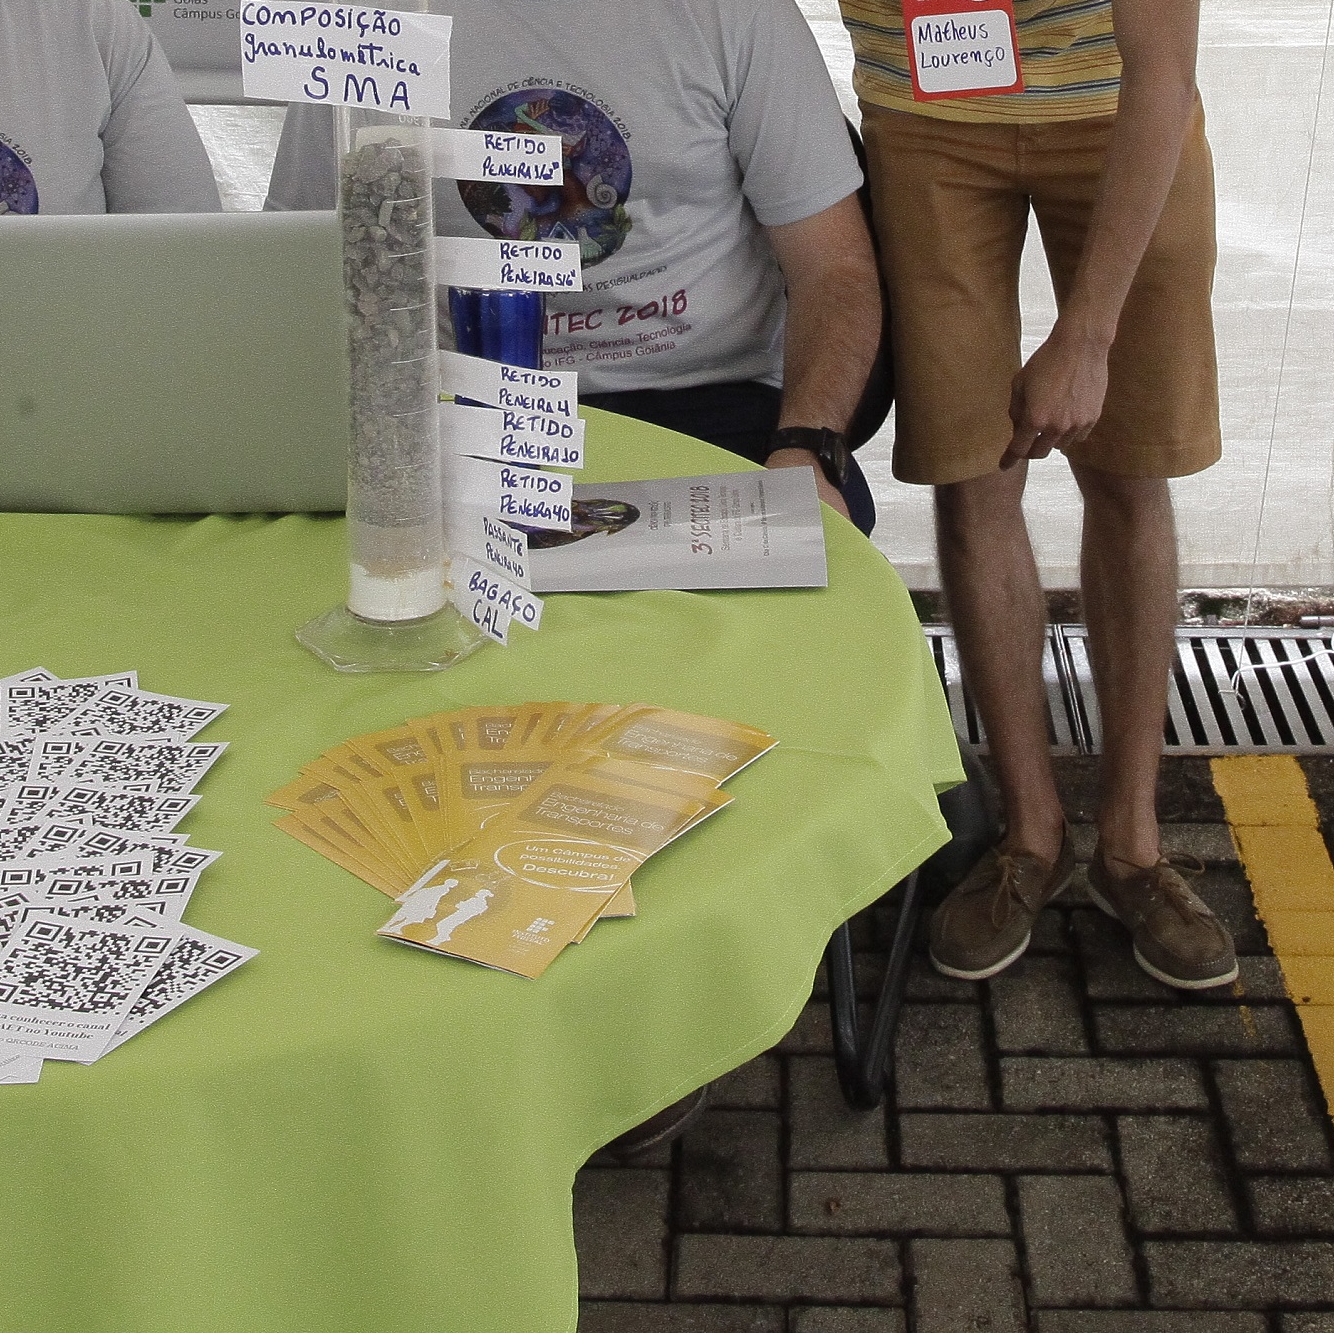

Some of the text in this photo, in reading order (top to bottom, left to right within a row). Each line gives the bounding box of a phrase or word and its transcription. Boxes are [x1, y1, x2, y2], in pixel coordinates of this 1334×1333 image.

[173, 7, 221, 22] Câmpus
[918, 19, 989, 44] Matheus
[921, 46, 1005, 69] Lourenço
[469, 87, 506, 117] NACIONAL
[613, 117, 633, 141] 2018
[12, 143, 34, 166] 2018
[485, 134, 546, 154] RETIDO
[500, 242, 562, 260] RETIDO
[543, 289, 688, 336] ITEC 2018
[637, 323, 693, 343] Tecnologia
[555, 357, 576, 366] IFG
[586, 349, 633, 363] Câmpus
[501, 366, 561, 388] RETIDO
[499, 388, 570, 417] PENEIRA 4
[503, 411, 573, 438] RETIDO
[500, 434, 559, 463] PENEIRA
[500, 468, 562, 493] RETIDO
[500, 494, 551, 520] PENEIRA
[483, 517, 523, 557] PASSANTE
[469, 571, 536, 622] BAGAÇO
[473, 598, 503, 639] CAL
[535, 806, 634, 835] Transportes
[542, 797, 665, 832] Engenharia de
[525, 845, 548, 853] Um
[552, 848, 610, 861] Câmpus
[10, 1013, 67, 1027] conhecer
[76, 1022, 112, 1031] canal
[43, 1028, 94, 1039] Youtube
